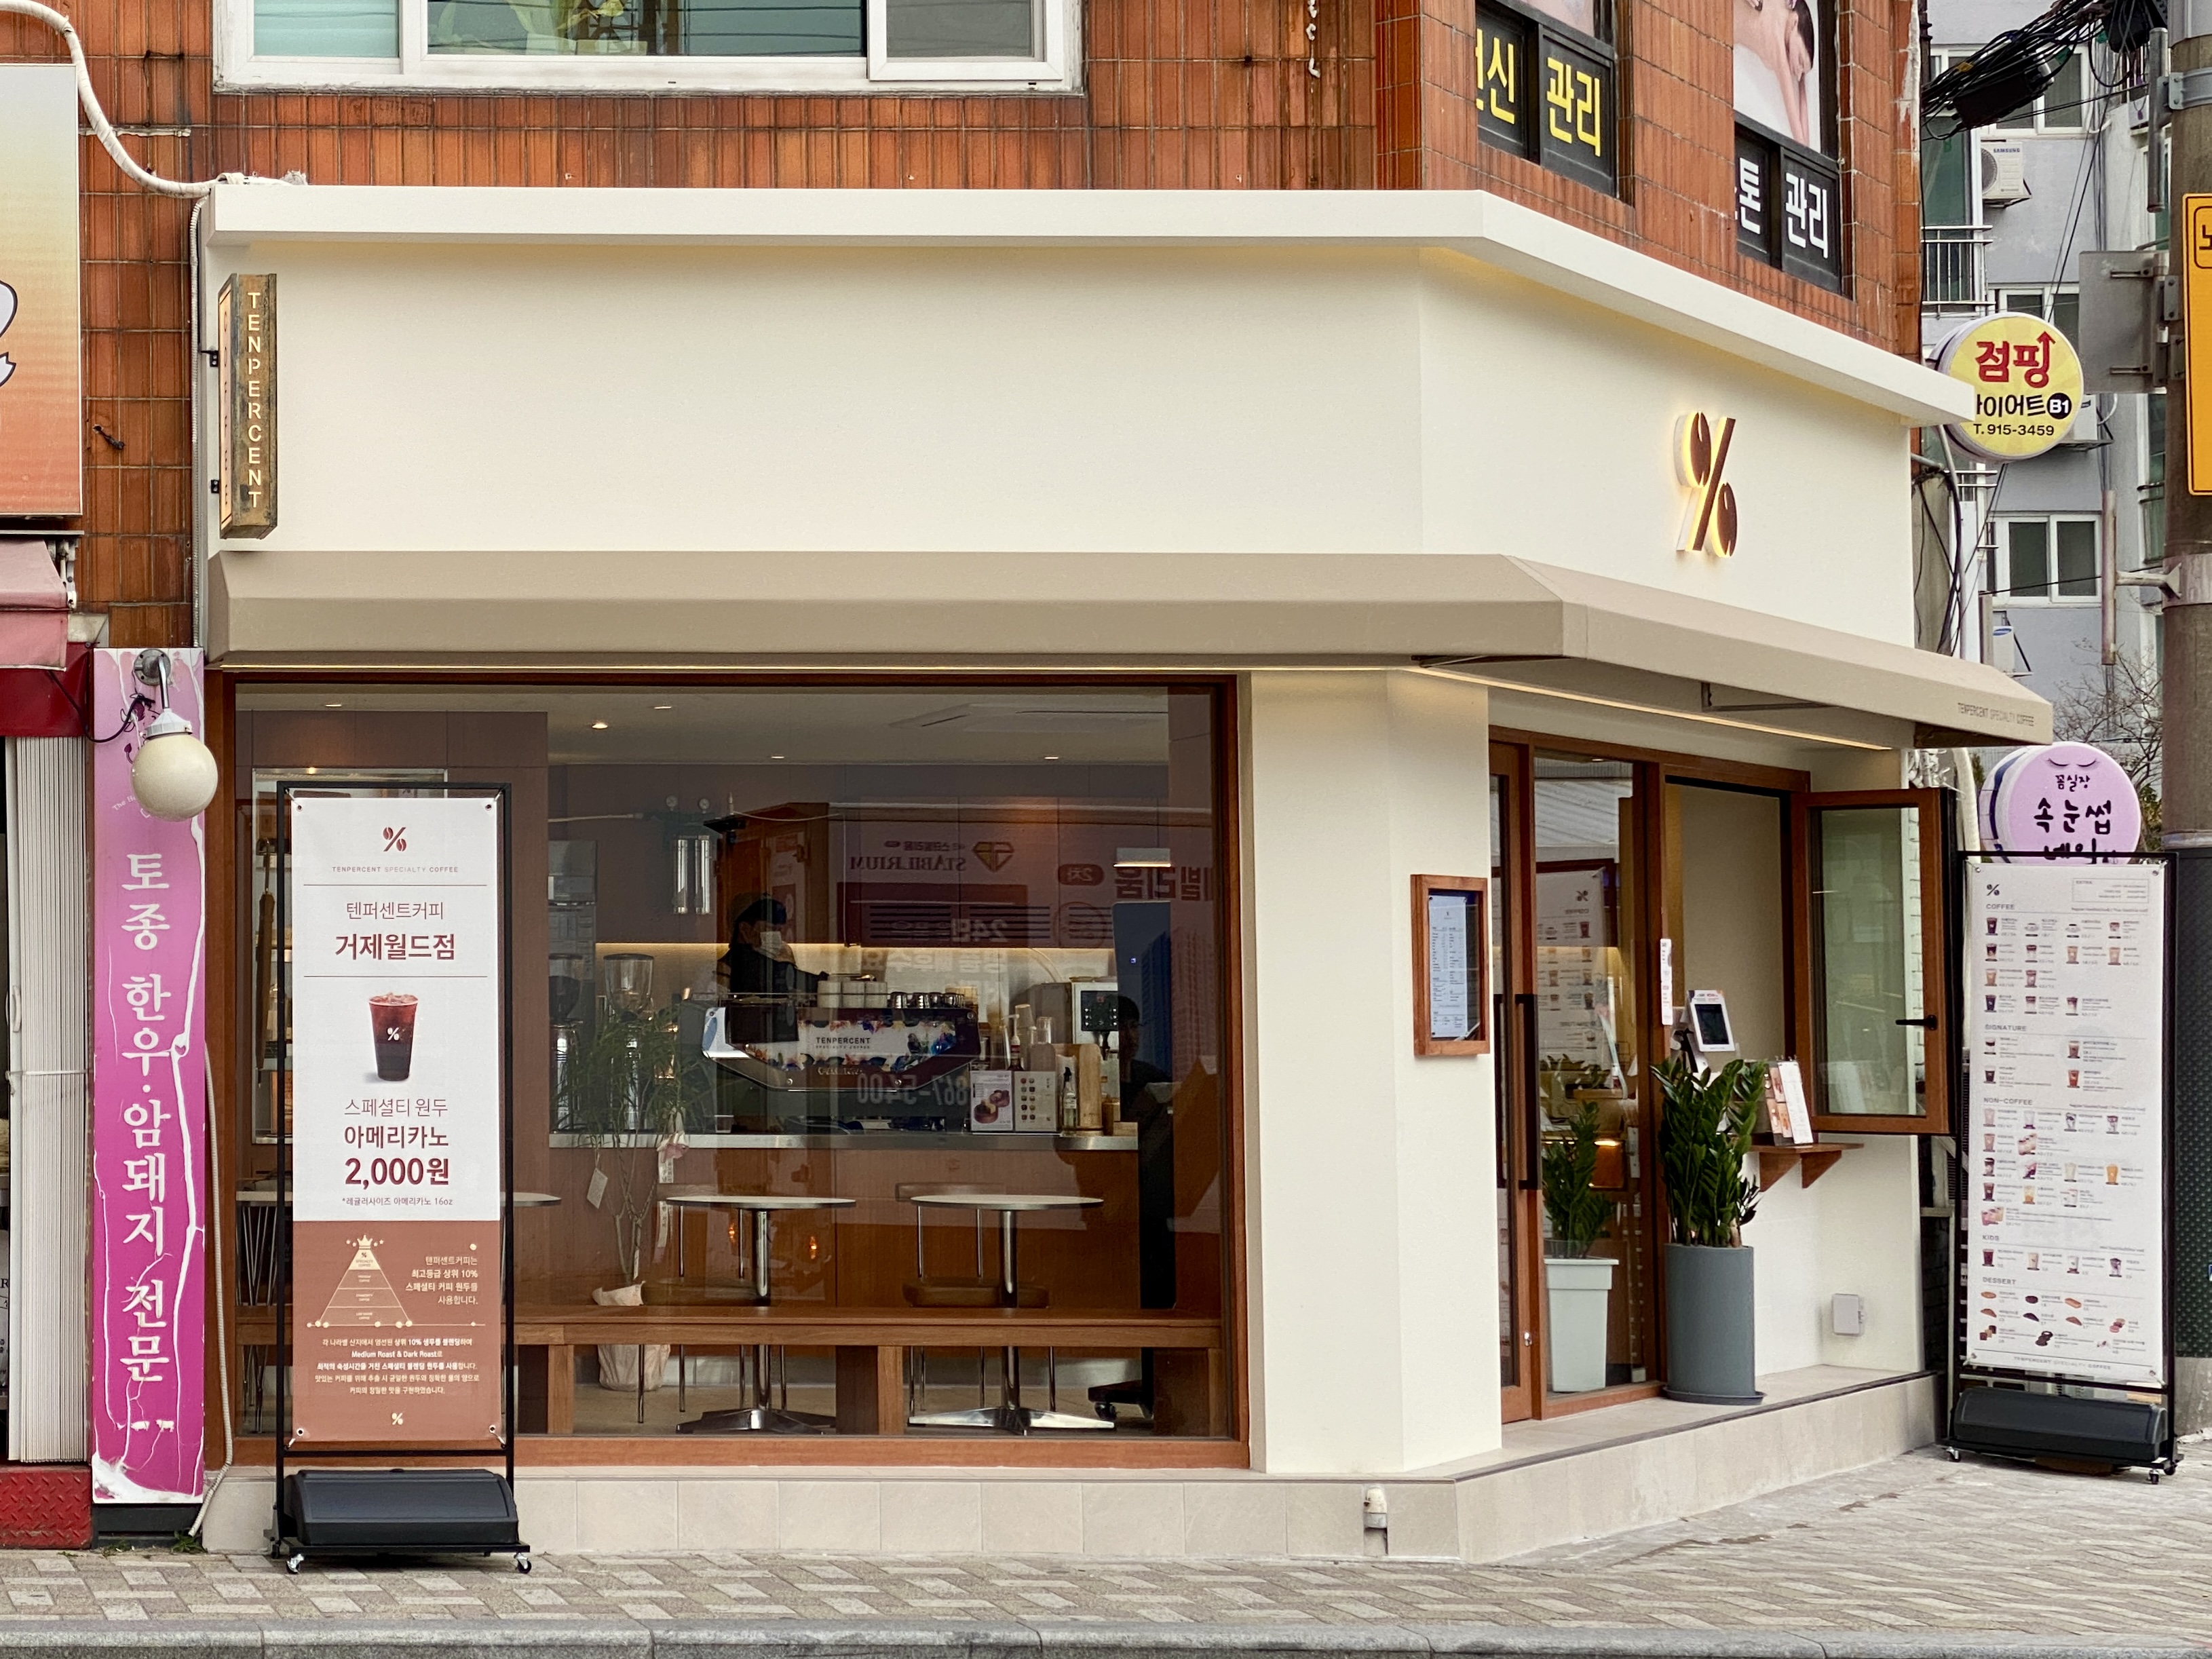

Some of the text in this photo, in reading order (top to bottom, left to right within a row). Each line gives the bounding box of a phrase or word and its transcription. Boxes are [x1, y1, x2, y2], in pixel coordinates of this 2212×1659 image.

[1546, 57, 1601, 157] 관리
[1734, 157, 1829, 259] 톤 관리
[1975, 330, 2056, 389] 점핑
[247, 292, 263, 508] TENPERCENT
[2049, 399, 2071, 414] B1
[2034, 797, 2112, 835] 속눈썹
[121, 854, 170, 951] 토종
[346, 901, 444, 920] 텐퍼센트커피
[335, 933, 455, 961] 거제월드점
[344, 1098, 449, 1117] 스페셜티 원두
[1983, 1097, 2033, 1105] NON-COFFEE
[344, 1125, 449, 1149] 아메리카노
[345, 1157, 449, 1190] 2,000원
[394, 1197, 431, 1206] 아메리카노
[435, 1197, 453, 1206] 16oz
[425, 1256, 478, 1265] 텐퍼센트커피는
[411, 1269, 478, 1279] 최고등급 상위 10%
[1982, 1276, 2017, 1285] DESSERT
[406, 1282, 478, 1292] 스페셜티 커피 원두를
[438, 1295, 478, 1305] 사용합니다.
[119, 1279, 170, 1383] 전문
[322, 1338, 328, 1347] 각
